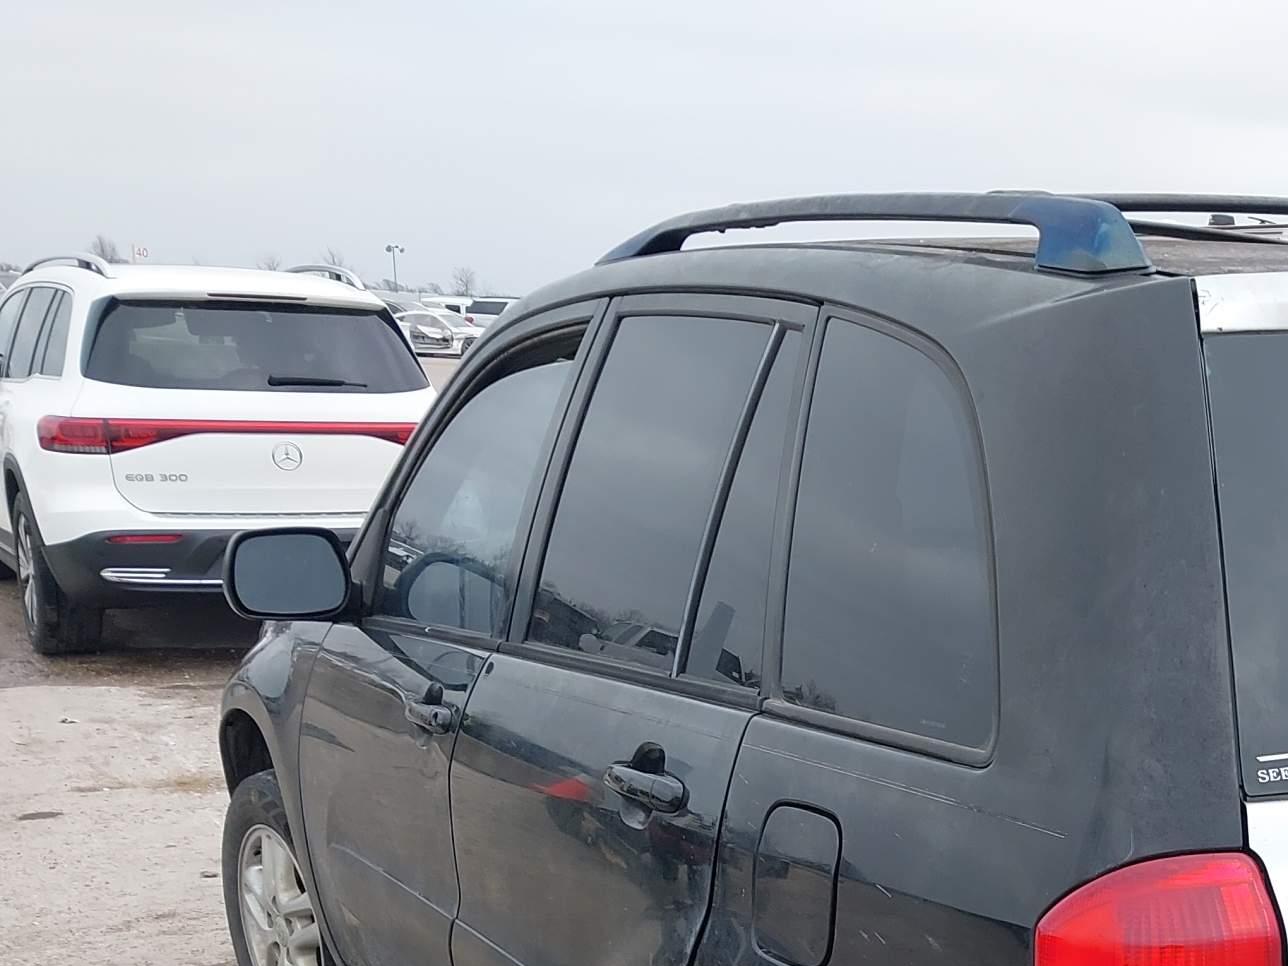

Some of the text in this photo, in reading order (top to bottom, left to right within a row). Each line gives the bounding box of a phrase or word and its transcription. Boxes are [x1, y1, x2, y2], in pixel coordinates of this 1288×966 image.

[136, 248, 148, 257] 40
[125, 473, 188, 482] EQB 300
